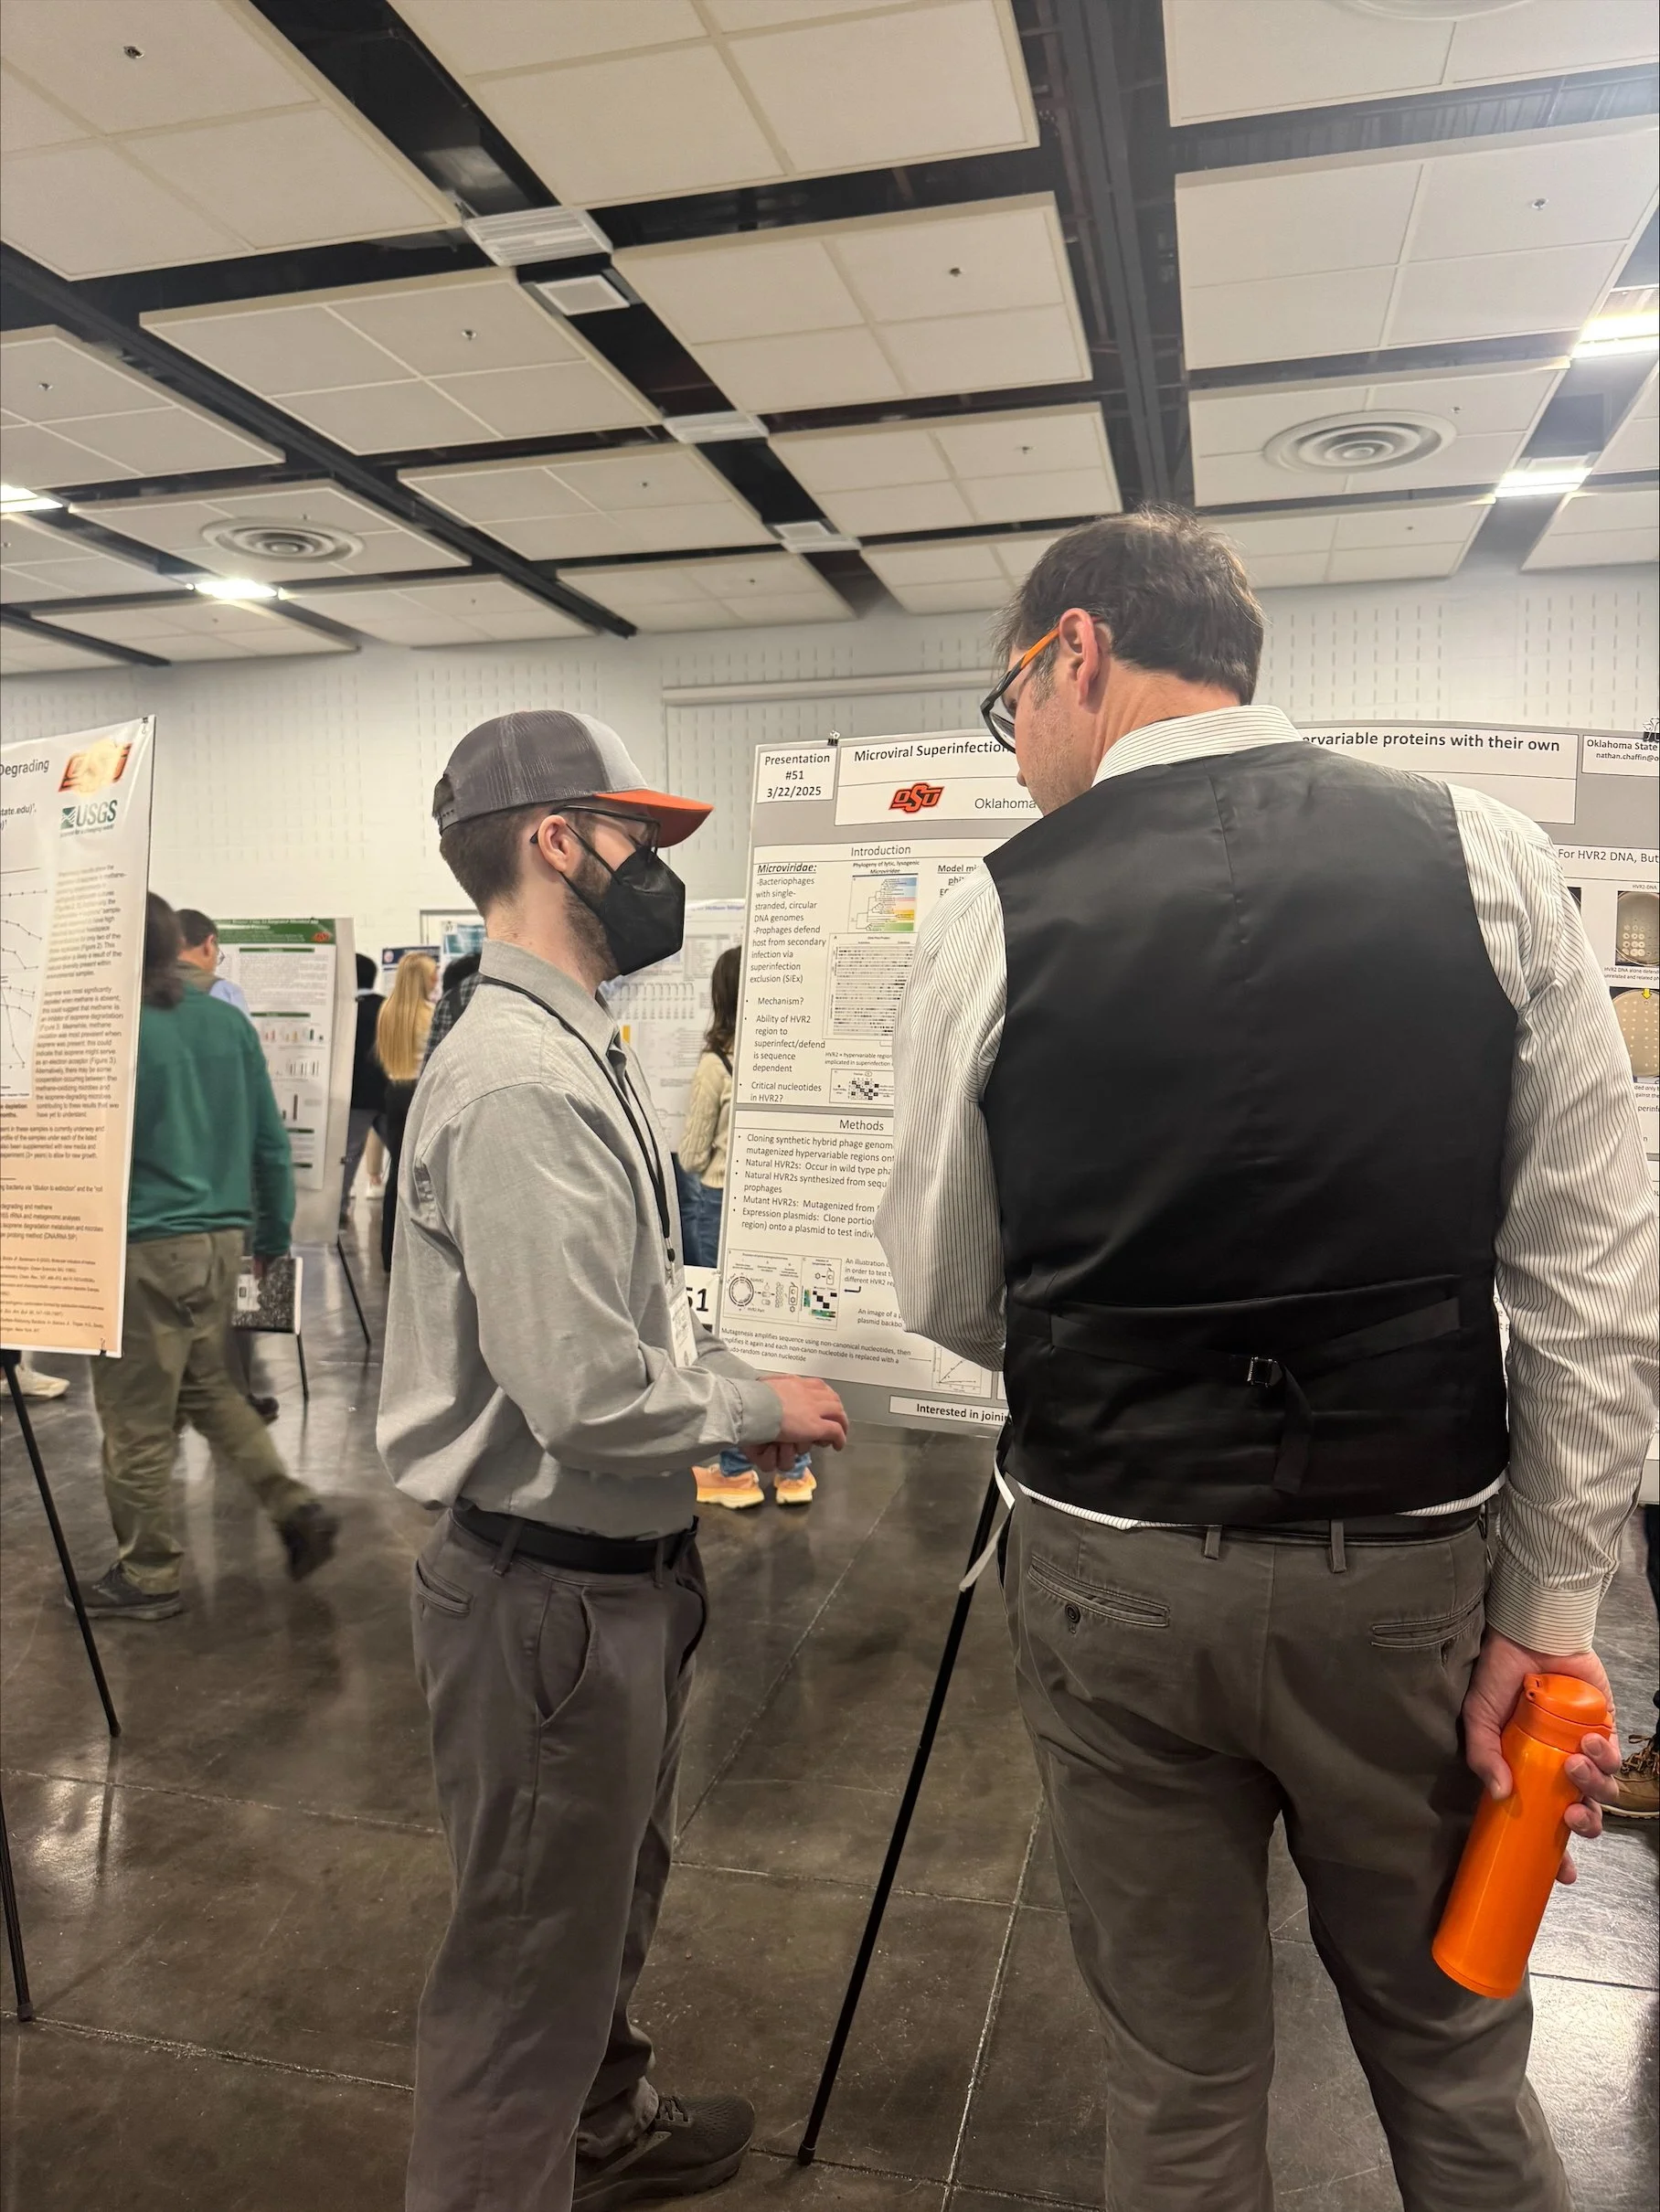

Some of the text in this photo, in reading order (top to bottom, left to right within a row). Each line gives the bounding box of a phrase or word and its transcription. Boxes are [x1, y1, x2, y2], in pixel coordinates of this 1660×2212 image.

[1383, 733, 1446, 748] proteins
[1450, 735, 1484, 748] with
[1488, 735, 1524, 750] their
[1528, 740, 1559, 751] own
[1587, 739, 1658, 751] Oklahoma State
[854, 740, 1009, 762] Microviral Superinfectio
[764, 753, 830, 766] Presentation
[785, 771, 804, 781] #51
[767, 786, 822, 799] 3/22/2025
[889, 782, 945, 814] OSU
[974, 797, 1037, 810] Oklahoma
[75, 800, 118, 827] USGS
[850, 845, 911, 857] Introduction
[1558, 848, 1659, 864] For HVR2 DNA, But
[757, 863, 817, 876] Microviridae:
[938, 865, 964, 873] Model
[757, 877, 815, 888] -Bacteriophages
[756, 890, 796, 899] with single-
[755, 901, 817, 911] stranded, circular
[771, 915, 804, 924] genomes
[753, 926, 821, 936] -Prophages defend
[752, 938, 826, 948] host from secondary
[751, 951, 793, 959] infection via
[751, 963, 801, 973] superinfection
[750, 974, 803, 984] exclusion (SiEx)
[757, 997, 804, 1005] Mechanism?
[756, 1016, 778, 1025] Ability
[780, 1016, 789, 1024] of
[755, 1027, 778, 1037] region
[754, 1040, 825, 1049] superinfect/defend
[761, 1053, 796, 1062] sequence
[753, 1064, 793, 1073] dependent
[751, 1081, 822, 1092] Critical nucleotides
[839, 1120, 884, 1131] Methods
[748, 1133, 774, 1143] Cloning
[776, 1136, 811, 1145] synthetic
[813, 1138, 837, 1147] hybrid
[839, 1140, 864, 1150] phage
[747, 1146, 793, 1157] mutagenized
[795, 1149, 848, 1161] hypervariable
[850, 1153, 879, 1163] regions
[746, 1158, 772, 1168] Natural
[774, 1161, 802, 1170] HVR2s:
[805, 1163, 828, 1171] Occur
[830, 1164, 837, 1172] in
[839, 1164, 856, 1173] wild
[857, 1165, 876, 1175] type
[745, 1171, 771, 1180] Natural
[773, 1173, 798, 1182] HVR2s
[800, 1175, 845, 1186] synthesized
[846, 1177, 866, 1186] from
[744, 1184, 782, 1194] prophages
[743, 1196, 875, 1212] Mutant HVR2s: Mutagenized from
[742, 1207, 782, 1218] Expression
[783, 1211, 820, 1221] plasmids:
[823, 1214, 846, 1223] Clone
[742, 1221, 768, 1231] region)
[795, 1224, 825, 1235] plasmid
[837, 1228, 853, 1237] test
[855, 1259, 885, 1267] illustration
[845, 1276, 868, 1284] different
[867, 1309, 885, 1317] image
[722, 1327, 753, 1337] Mutagenesis
[755, 1332, 778, 1340] amplifies
[779, 1335, 804, 1344] sequence
[821, 1340, 860, 1350] non-canonical
[861, 1345, 896, 1355] nucleotides,
[779, 1354, 806, 1362] nucleotide
[789, 1345, 817, 1354] non-canon
[819, 1349, 848, 1358] nucleotide
[856, 1354, 879, 1362] replaced
[917, 1404, 967, 1418] Interested
[969, 1409, 979, 1419] in
